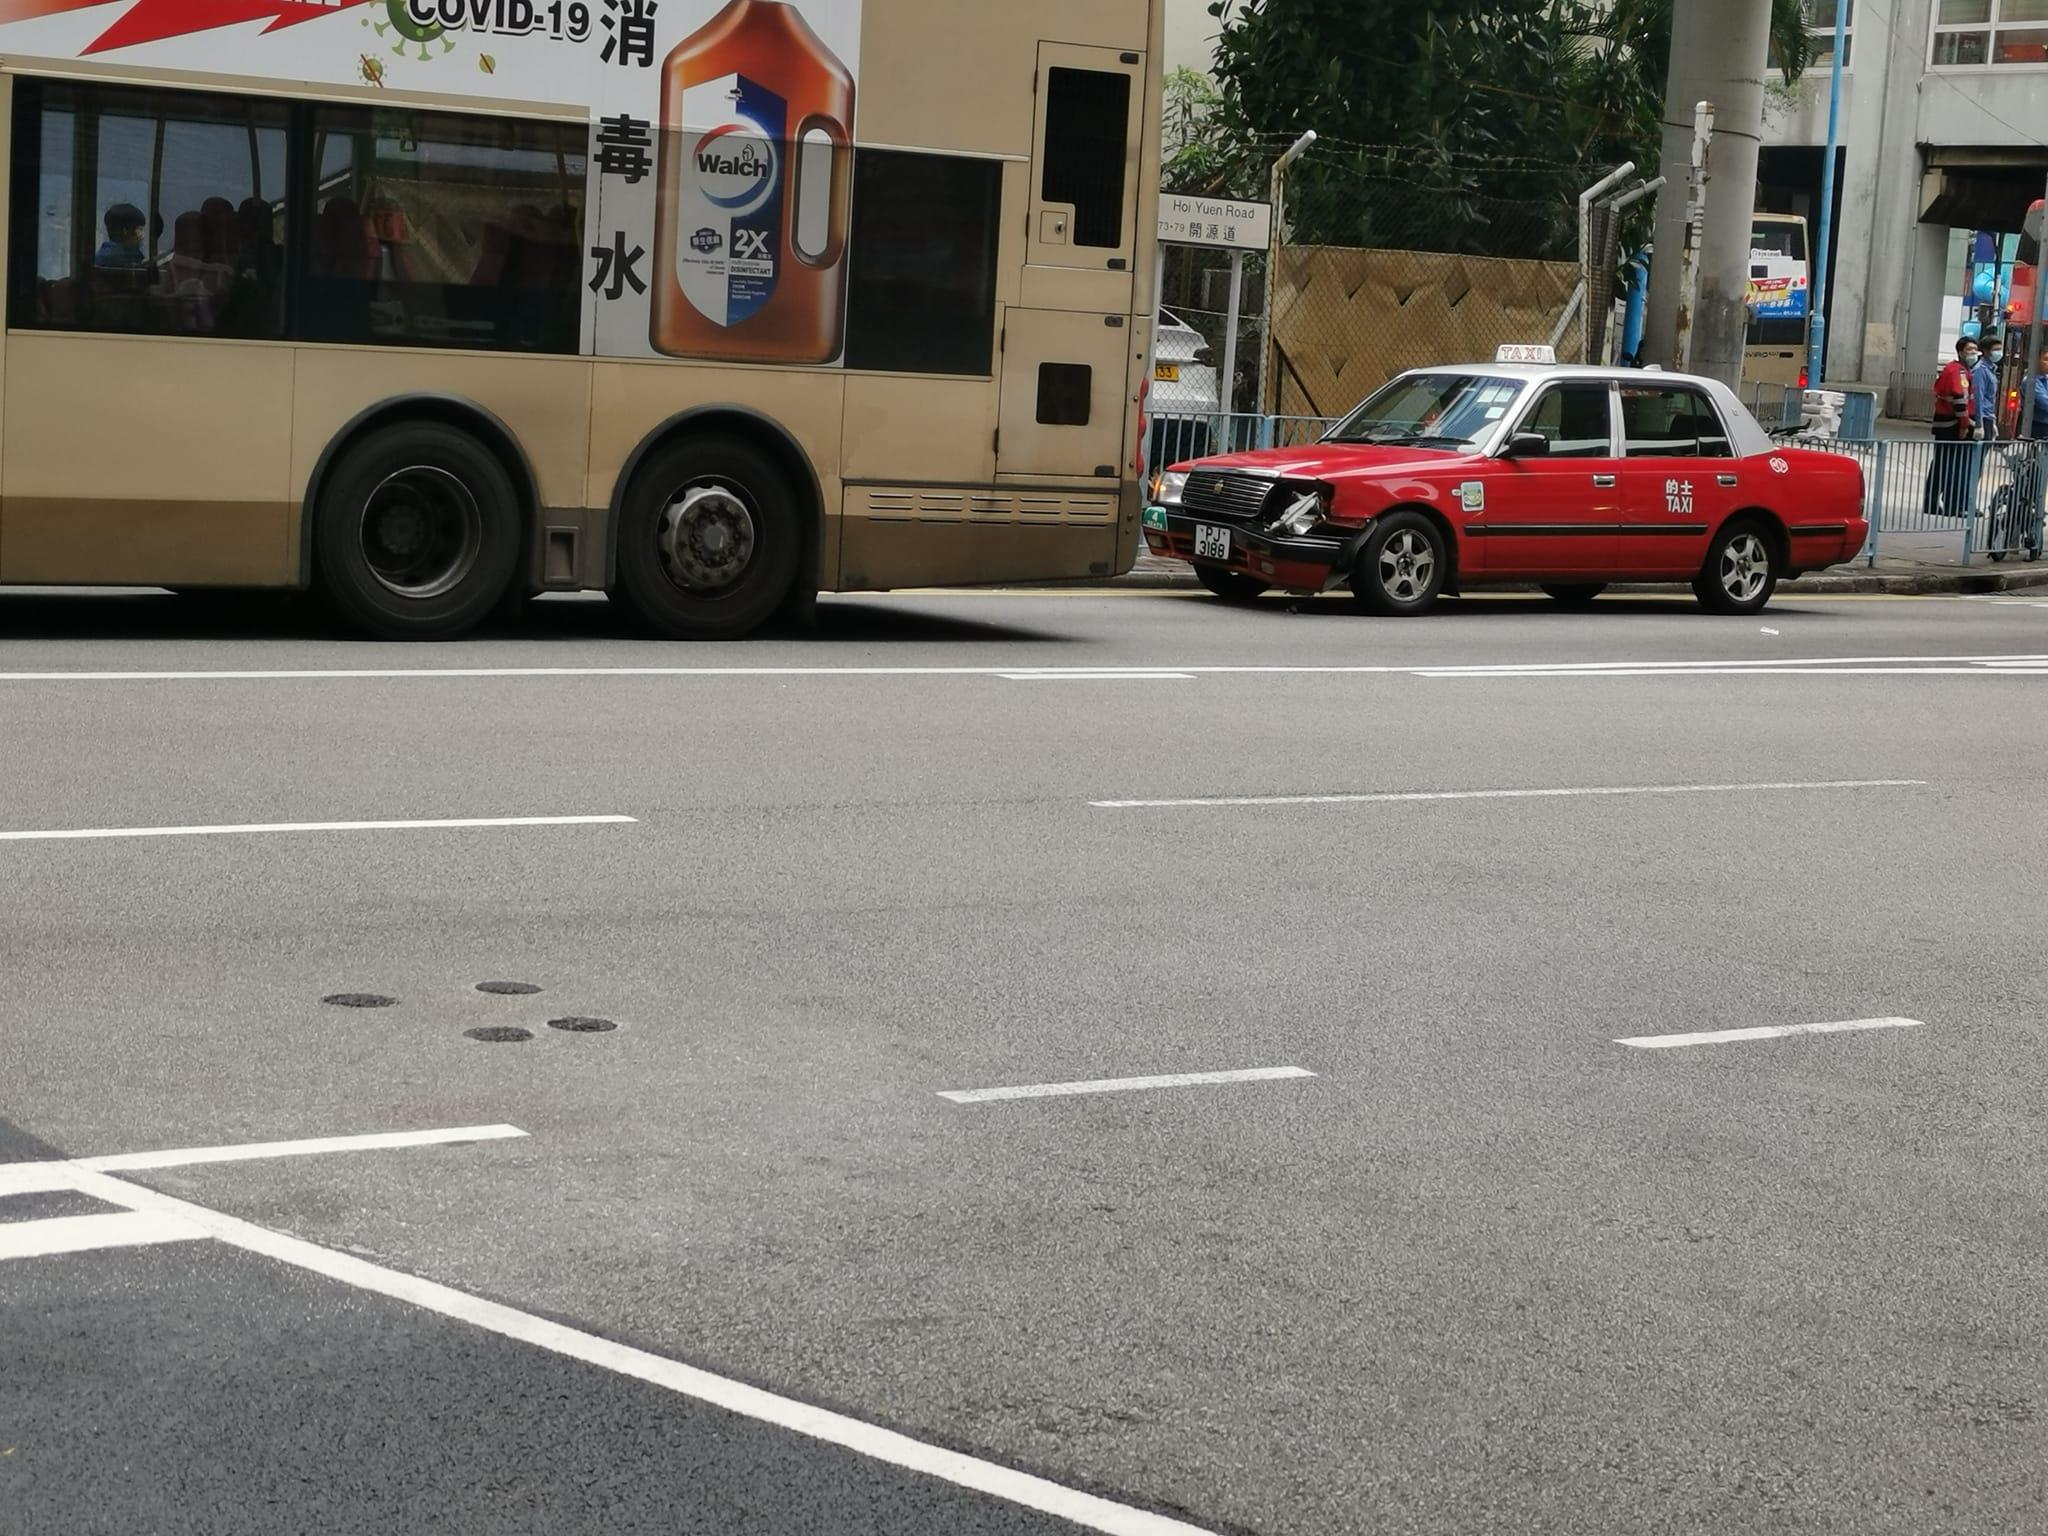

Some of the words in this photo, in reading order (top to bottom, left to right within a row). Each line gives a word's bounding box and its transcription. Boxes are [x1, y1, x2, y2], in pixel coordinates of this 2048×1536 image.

[407, 0, 591, 41] COVID-19
[588, 0, 658, 300] 消毒水
[698, 153, 767, 177] Walch
[1173, 200, 1191, 213] Hoi
[1196, 201, 1222, 217] Yuen
[1226, 204, 1255, 219] Road
[1189, 222, 1236, 241] 開源道
[735, 229, 768, 258] 2X
[1502, 347, 1542, 360] TAXI
[1665, 479, 1693, 495] 的士
[1666, 496, 1693, 513] TAXI
[1151, 511, 1158, 521] 4
[1206, 526, 1220, 542] PJ
[1200, 541, 1225, 558] 3188
